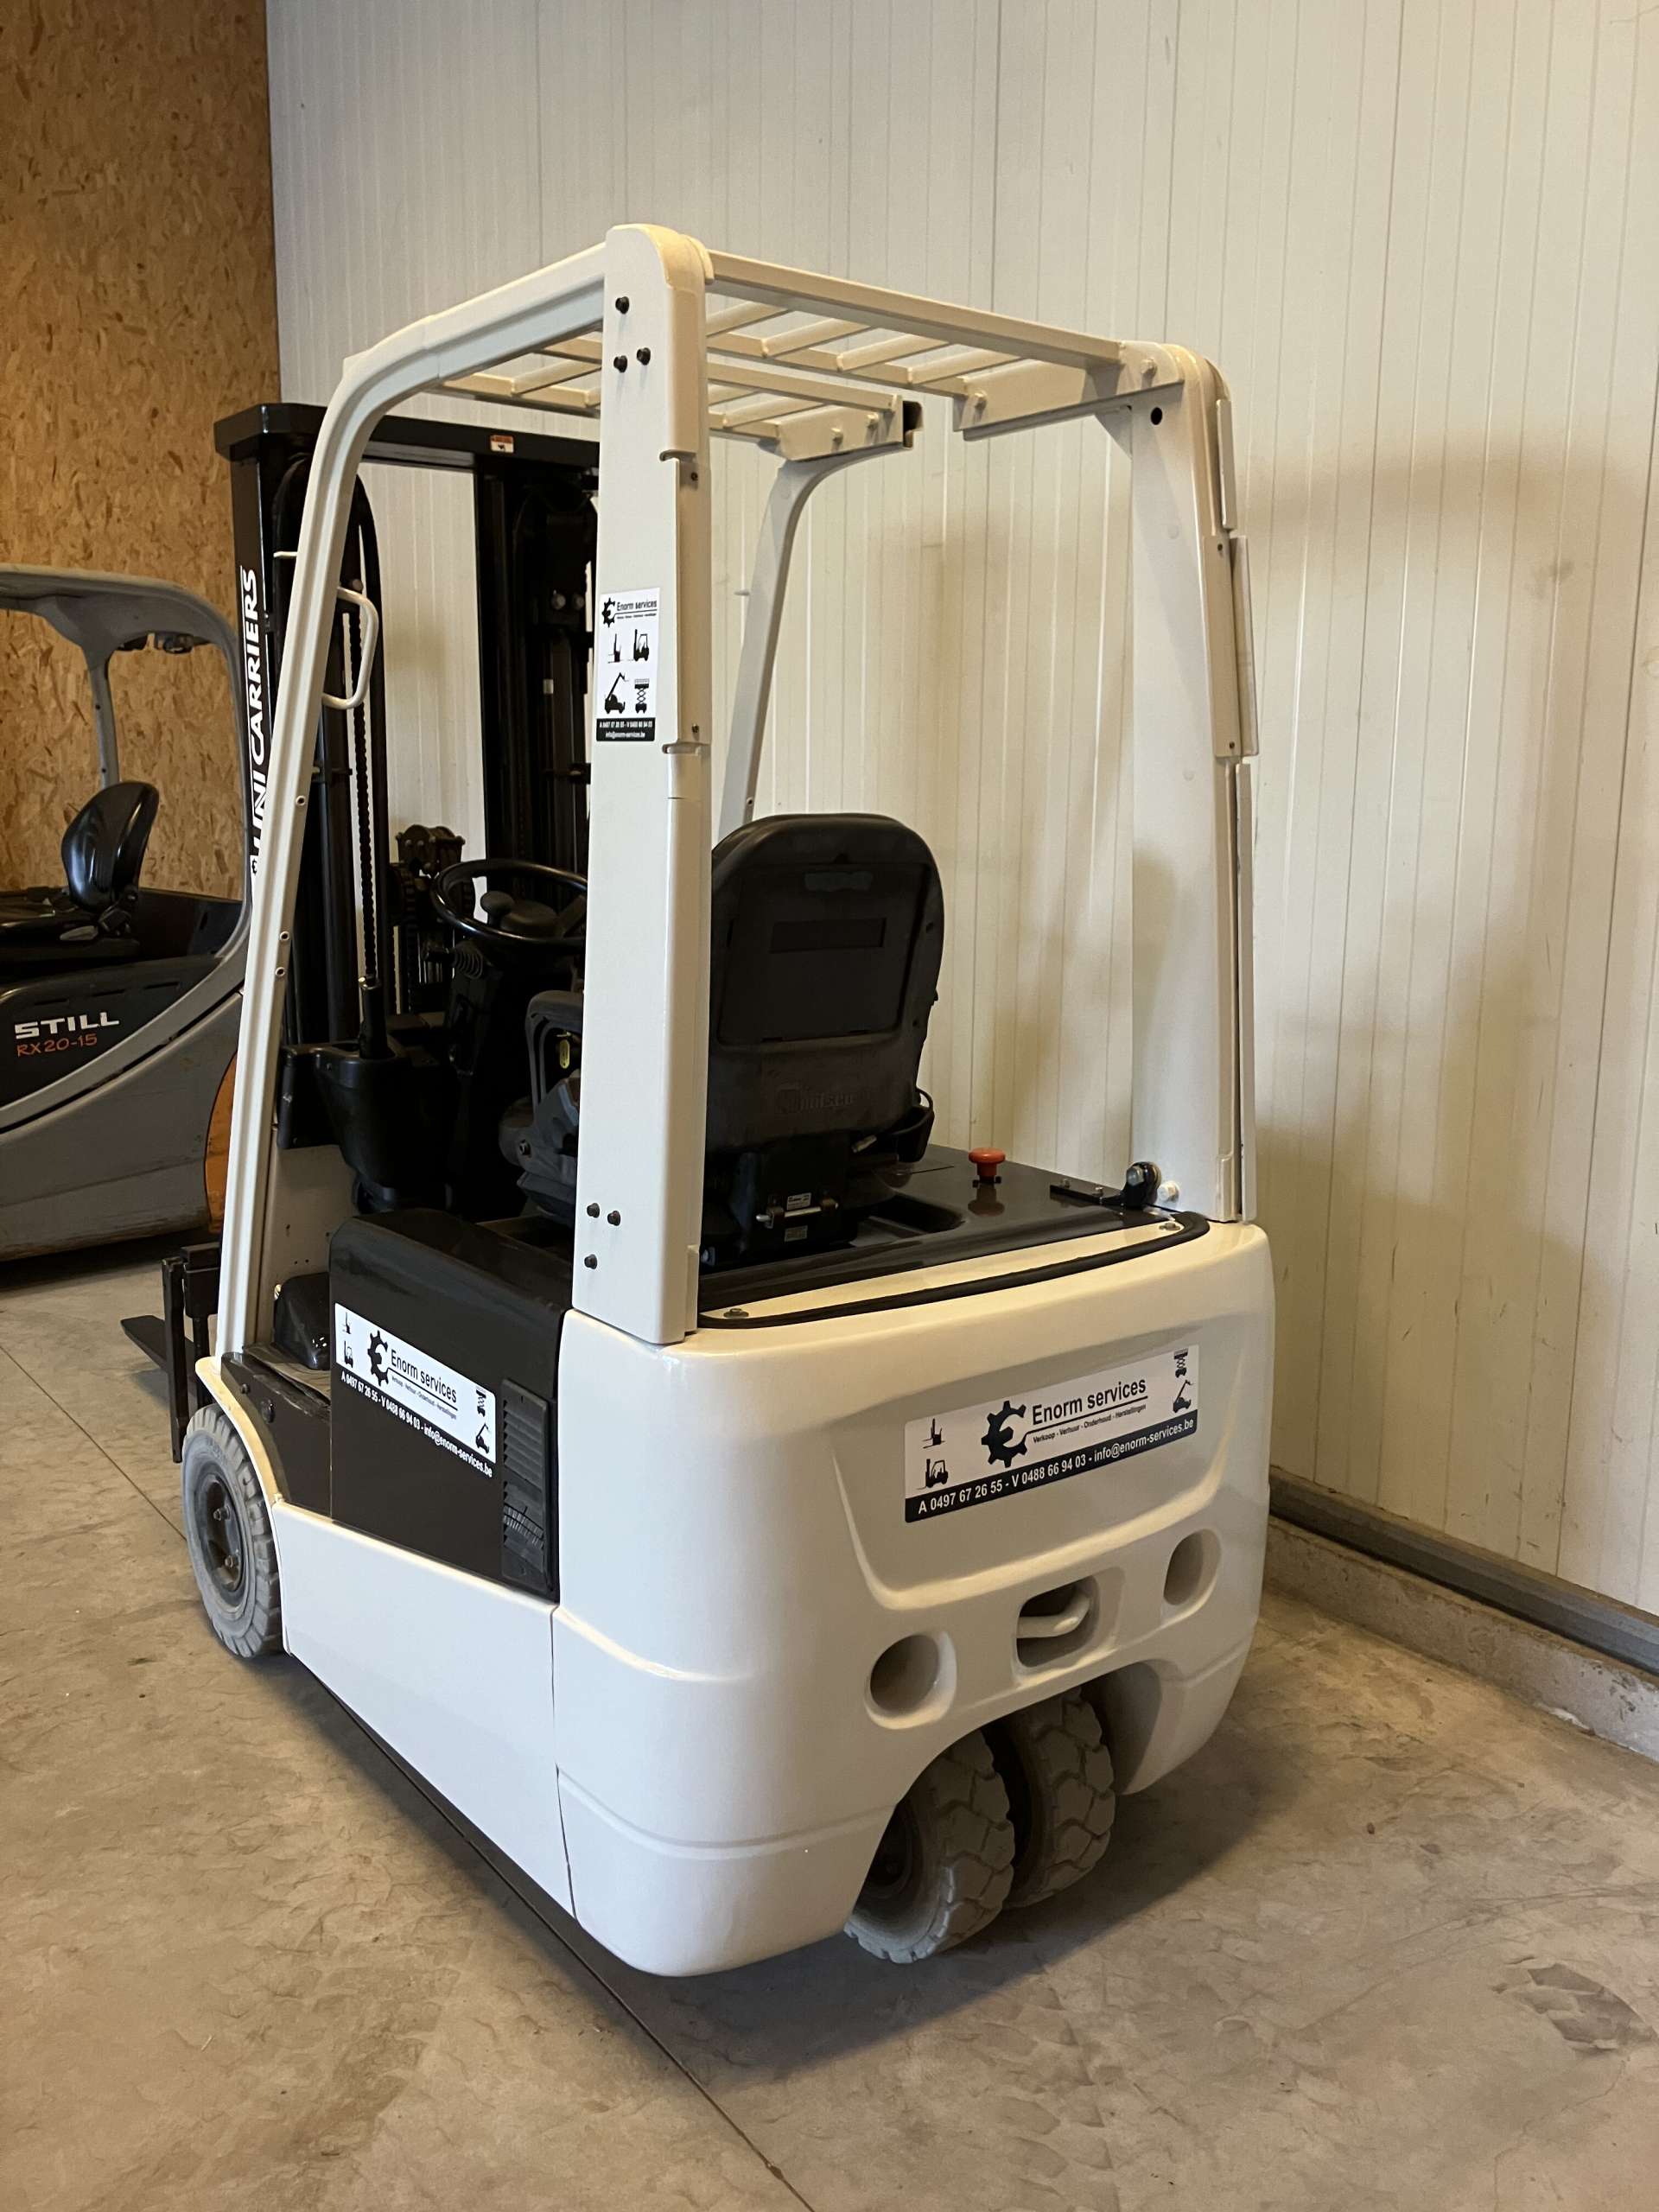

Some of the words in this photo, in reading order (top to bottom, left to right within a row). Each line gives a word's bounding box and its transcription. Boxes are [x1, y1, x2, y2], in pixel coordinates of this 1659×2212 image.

[14, 1012, 119, 1039] STILL
[391, 1349, 418, 1380] Enorm
[420, 1370, 457, 1404] services
[1033, 1397, 1083, 1426] Enorm
[1087, 1379, 1147, 1409] services
[340, 1370, 346, 1382] A
[381, 1395, 386, 1408] V
[413, 1416, 421, 1430] 03
[423, 1423, 493, 1478] info@enorm-services.be
[918, 1500, 927, 1515] A
[931, 1492, 956, 1511] 0497
[959, 1488, 973, 1503] 67
[975, 1484, 988, 1500] 26
[990, 1480, 1003, 1496] 55
[1011, 1473, 1020, 1487] V
[1021, 1467, 1046, 1484] 0488
[1047, 1461, 1060, 1477] 66
[1061, 1458, 1073, 1472] 94
[1075, 1453, 1087, 1467] 03
[1093, 1417, 1195, 1462] info@enorm-services.be
